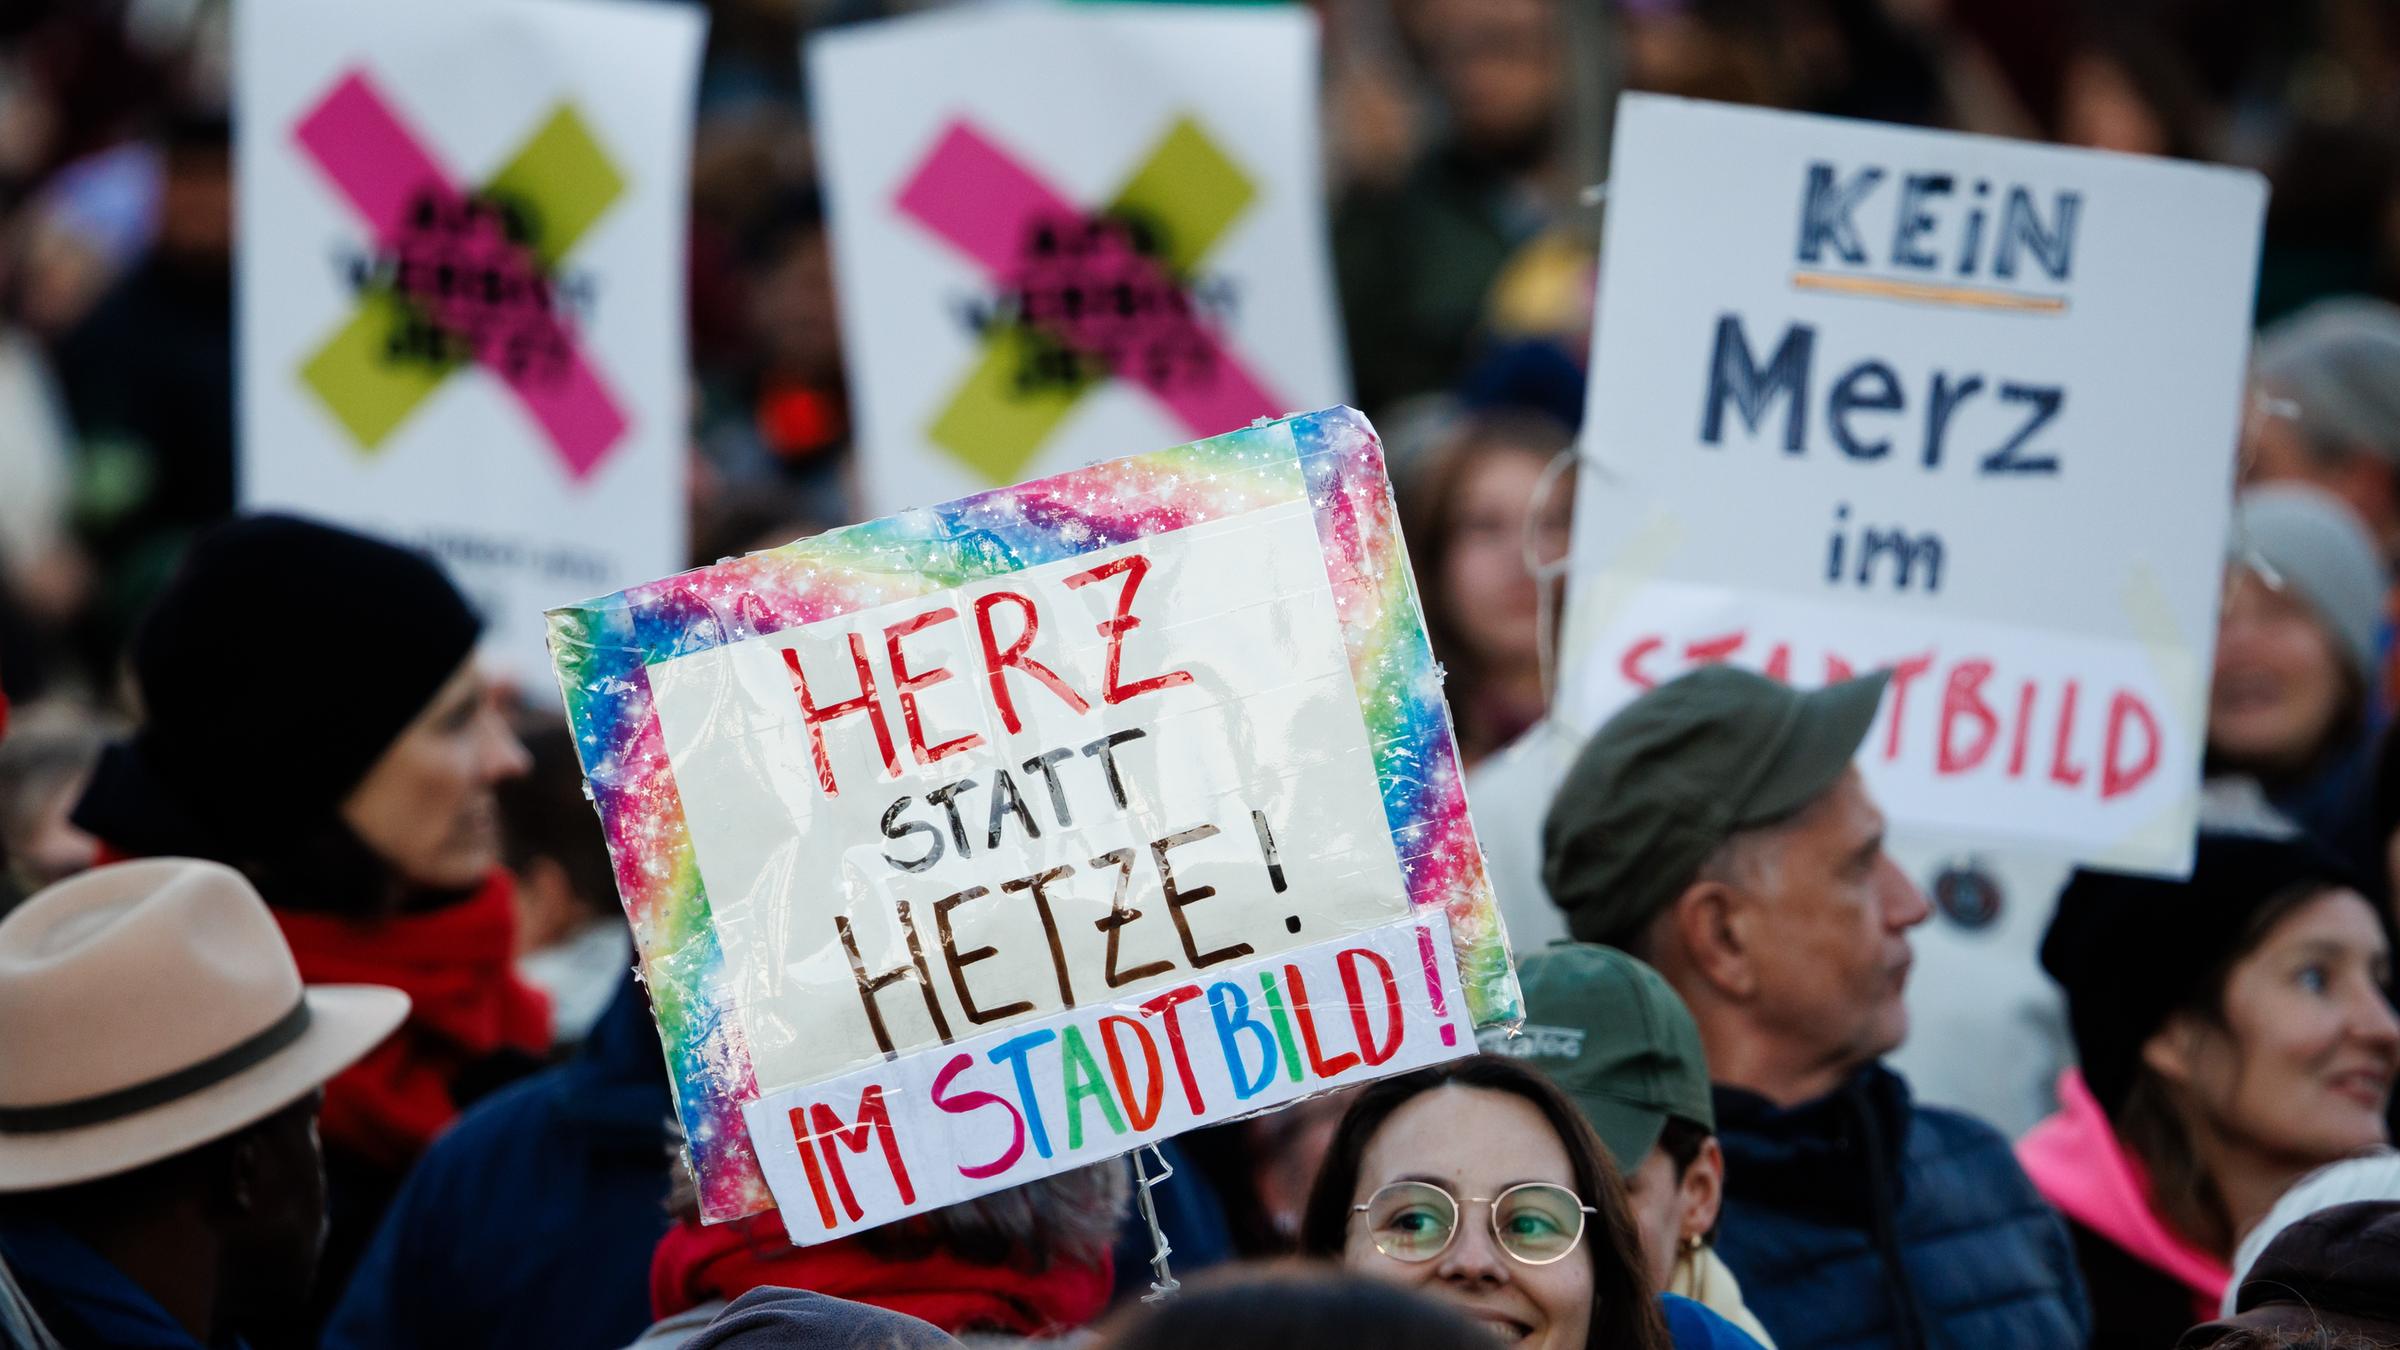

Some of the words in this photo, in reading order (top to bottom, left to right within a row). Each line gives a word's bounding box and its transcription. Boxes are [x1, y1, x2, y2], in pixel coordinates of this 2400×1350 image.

[1698, 313, 2067, 477] Merz
[1824, 506, 1947, 592] im
[781, 553, 1193, 797] HERZ
[1620, 630, 2161, 802] STBILD
[881, 728, 1147, 874] STATT
[789, 1083, 917, 1230] IM
